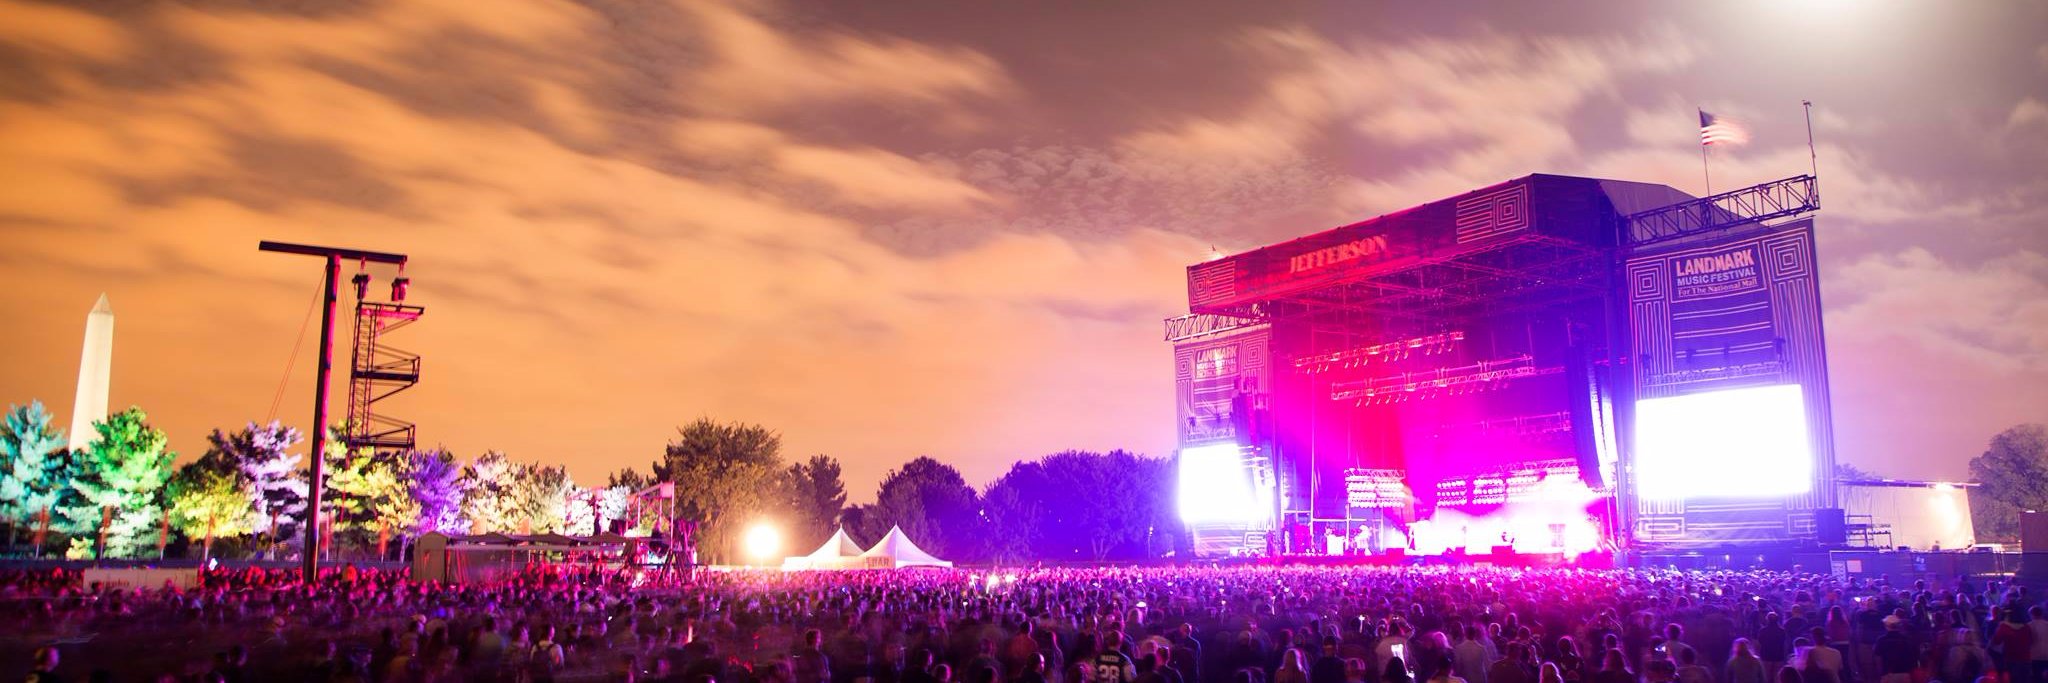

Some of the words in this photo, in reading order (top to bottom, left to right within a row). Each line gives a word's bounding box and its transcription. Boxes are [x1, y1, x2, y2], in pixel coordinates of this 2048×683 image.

[1290, 234, 1388, 274] JEFFERSON
[1676, 249, 1755, 276] LANDMARK
[1677, 275, 1709, 286] MUSIC
[1710, 267, 1756, 283] FESTIVAL
[1678, 287, 1690, 296] For
[1692, 287, 1707, 295] The
[1707, 281, 1741, 292] National
[1742, 277, 1758, 286] Mall
